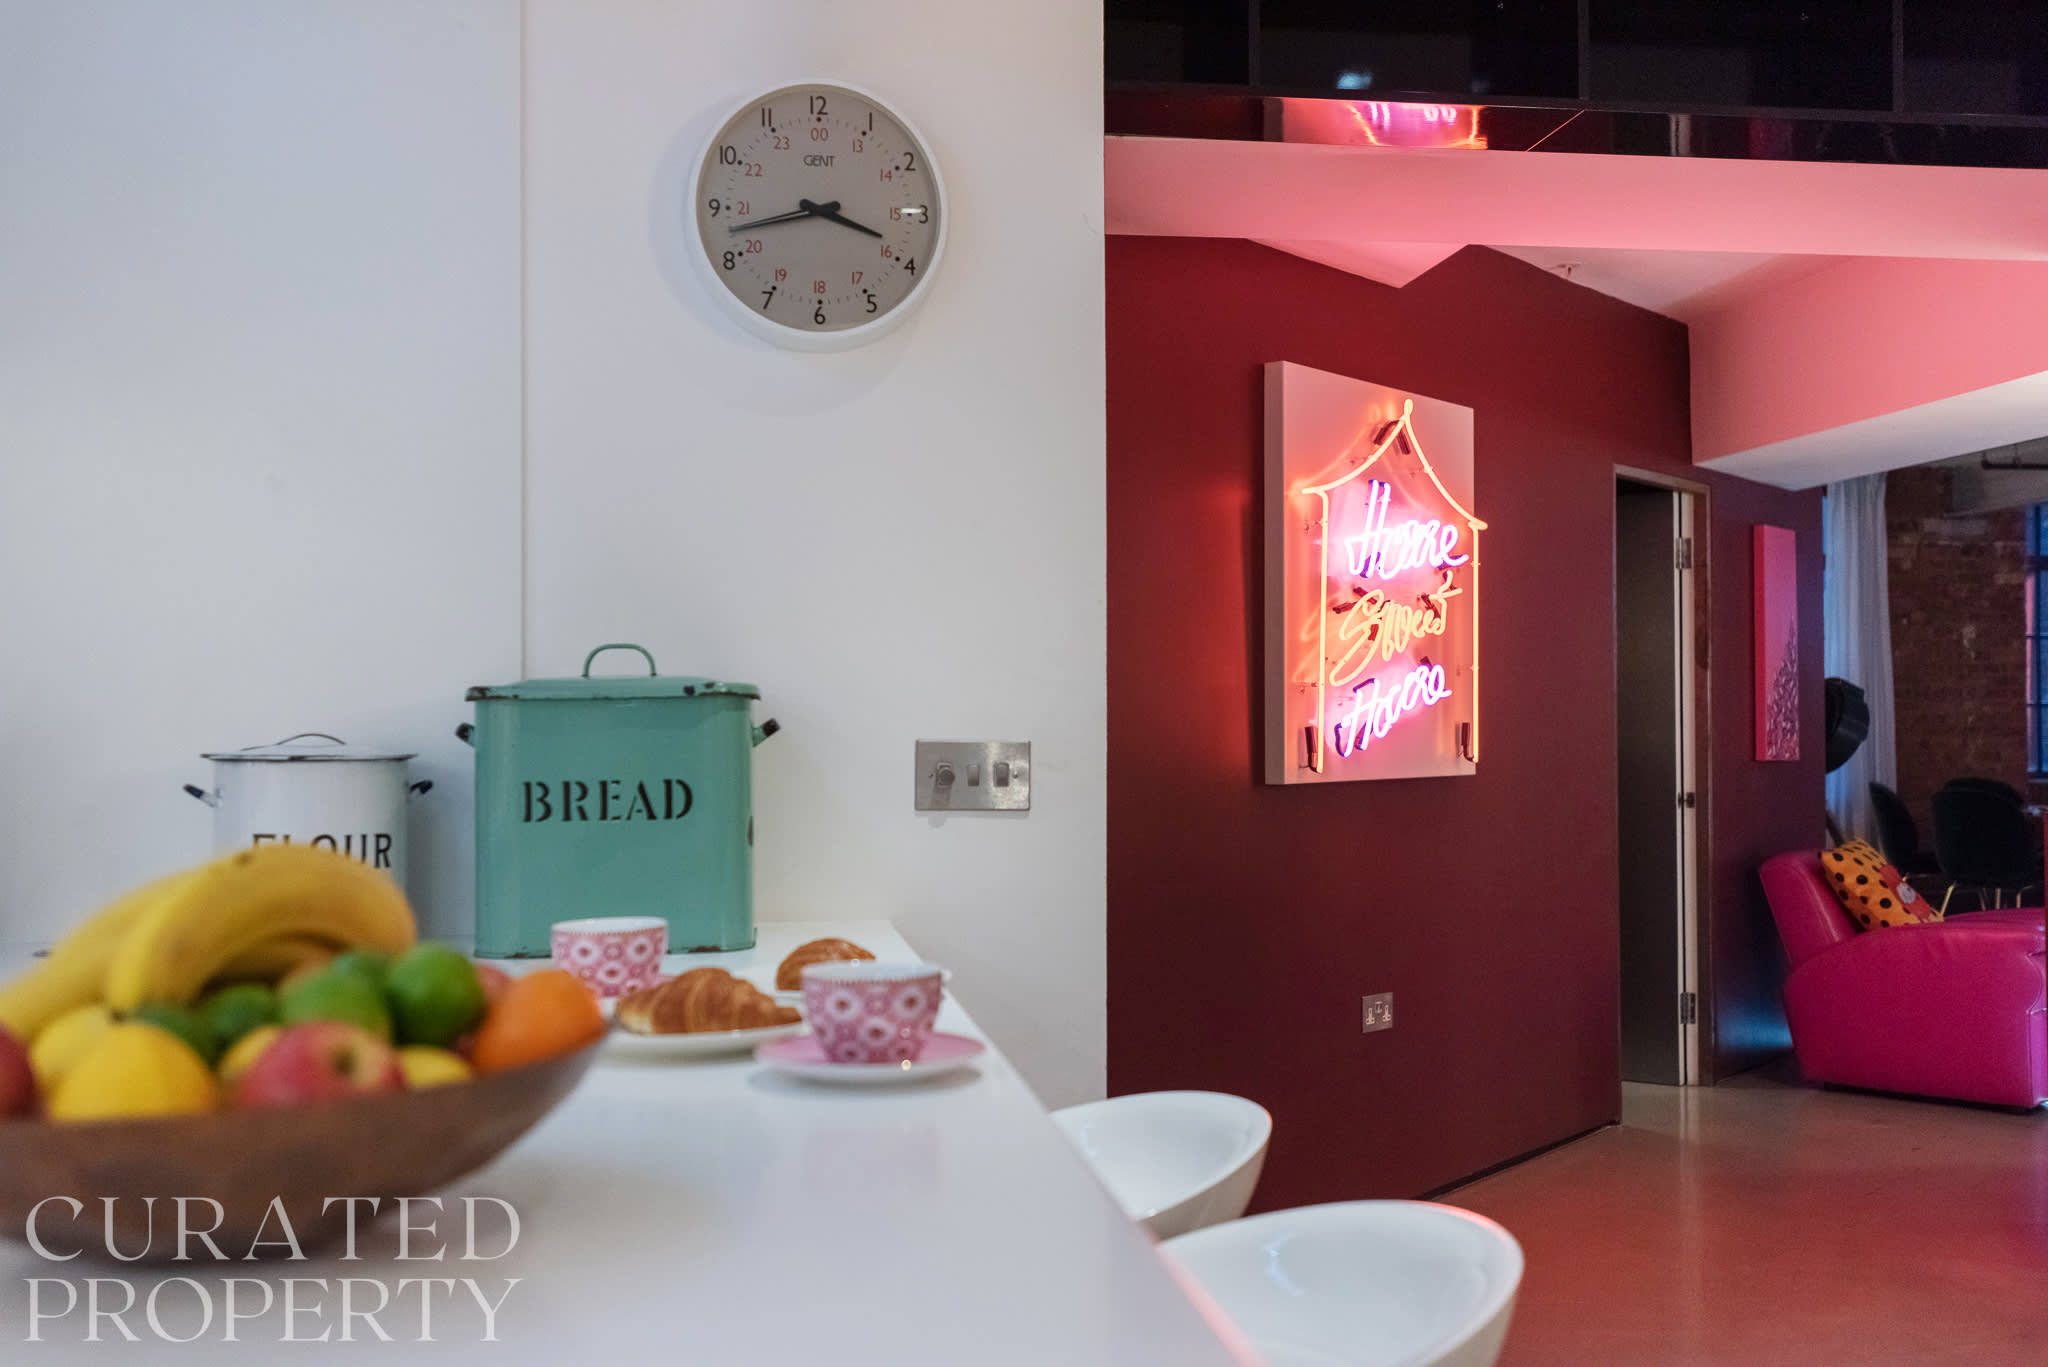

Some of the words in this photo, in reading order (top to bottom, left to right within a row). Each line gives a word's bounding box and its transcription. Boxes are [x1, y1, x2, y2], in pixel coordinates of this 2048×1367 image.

[809, 96, 828, 115] 12
[762, 108, 772, 127] 11
[774, 137, 790, 150] 23
[811, 128, 828, 141] 00
[852, 140, 863, 152] 13
[720, 146, 736, 165] 10
[803, 155, 835, 167] GENT
[904, 152, 916, 171] 2
[745, 164, 762, 176] 22
[880, 170, 892, 182] 14
[709, 199, 720, 217] 9
[737, 202, 749, 215] 21
[890, 208, 901, 220] 15
[919, 205, 928, 223] 3
[745, 240, 762, 253] 20
[880, 245, 892, 258] 16
[723, 251, 735, 270] 8
[904, 257, 916, 275] 4
[775, 269, 786, 281] 19
[851, 272, 863, 284] 17
[814, 281, 825, 293] 18
[762, 291, 773, 309] 7
[866, 294, 877, 312] 5
[814, 306, 825, 325] 6
[1344, 480, 1469, 579] Home
[1330, 570, 1463, 687] Sweet
[1335, 664, 1453, 758] Home
[523, 779, 693, 822] BREAD
